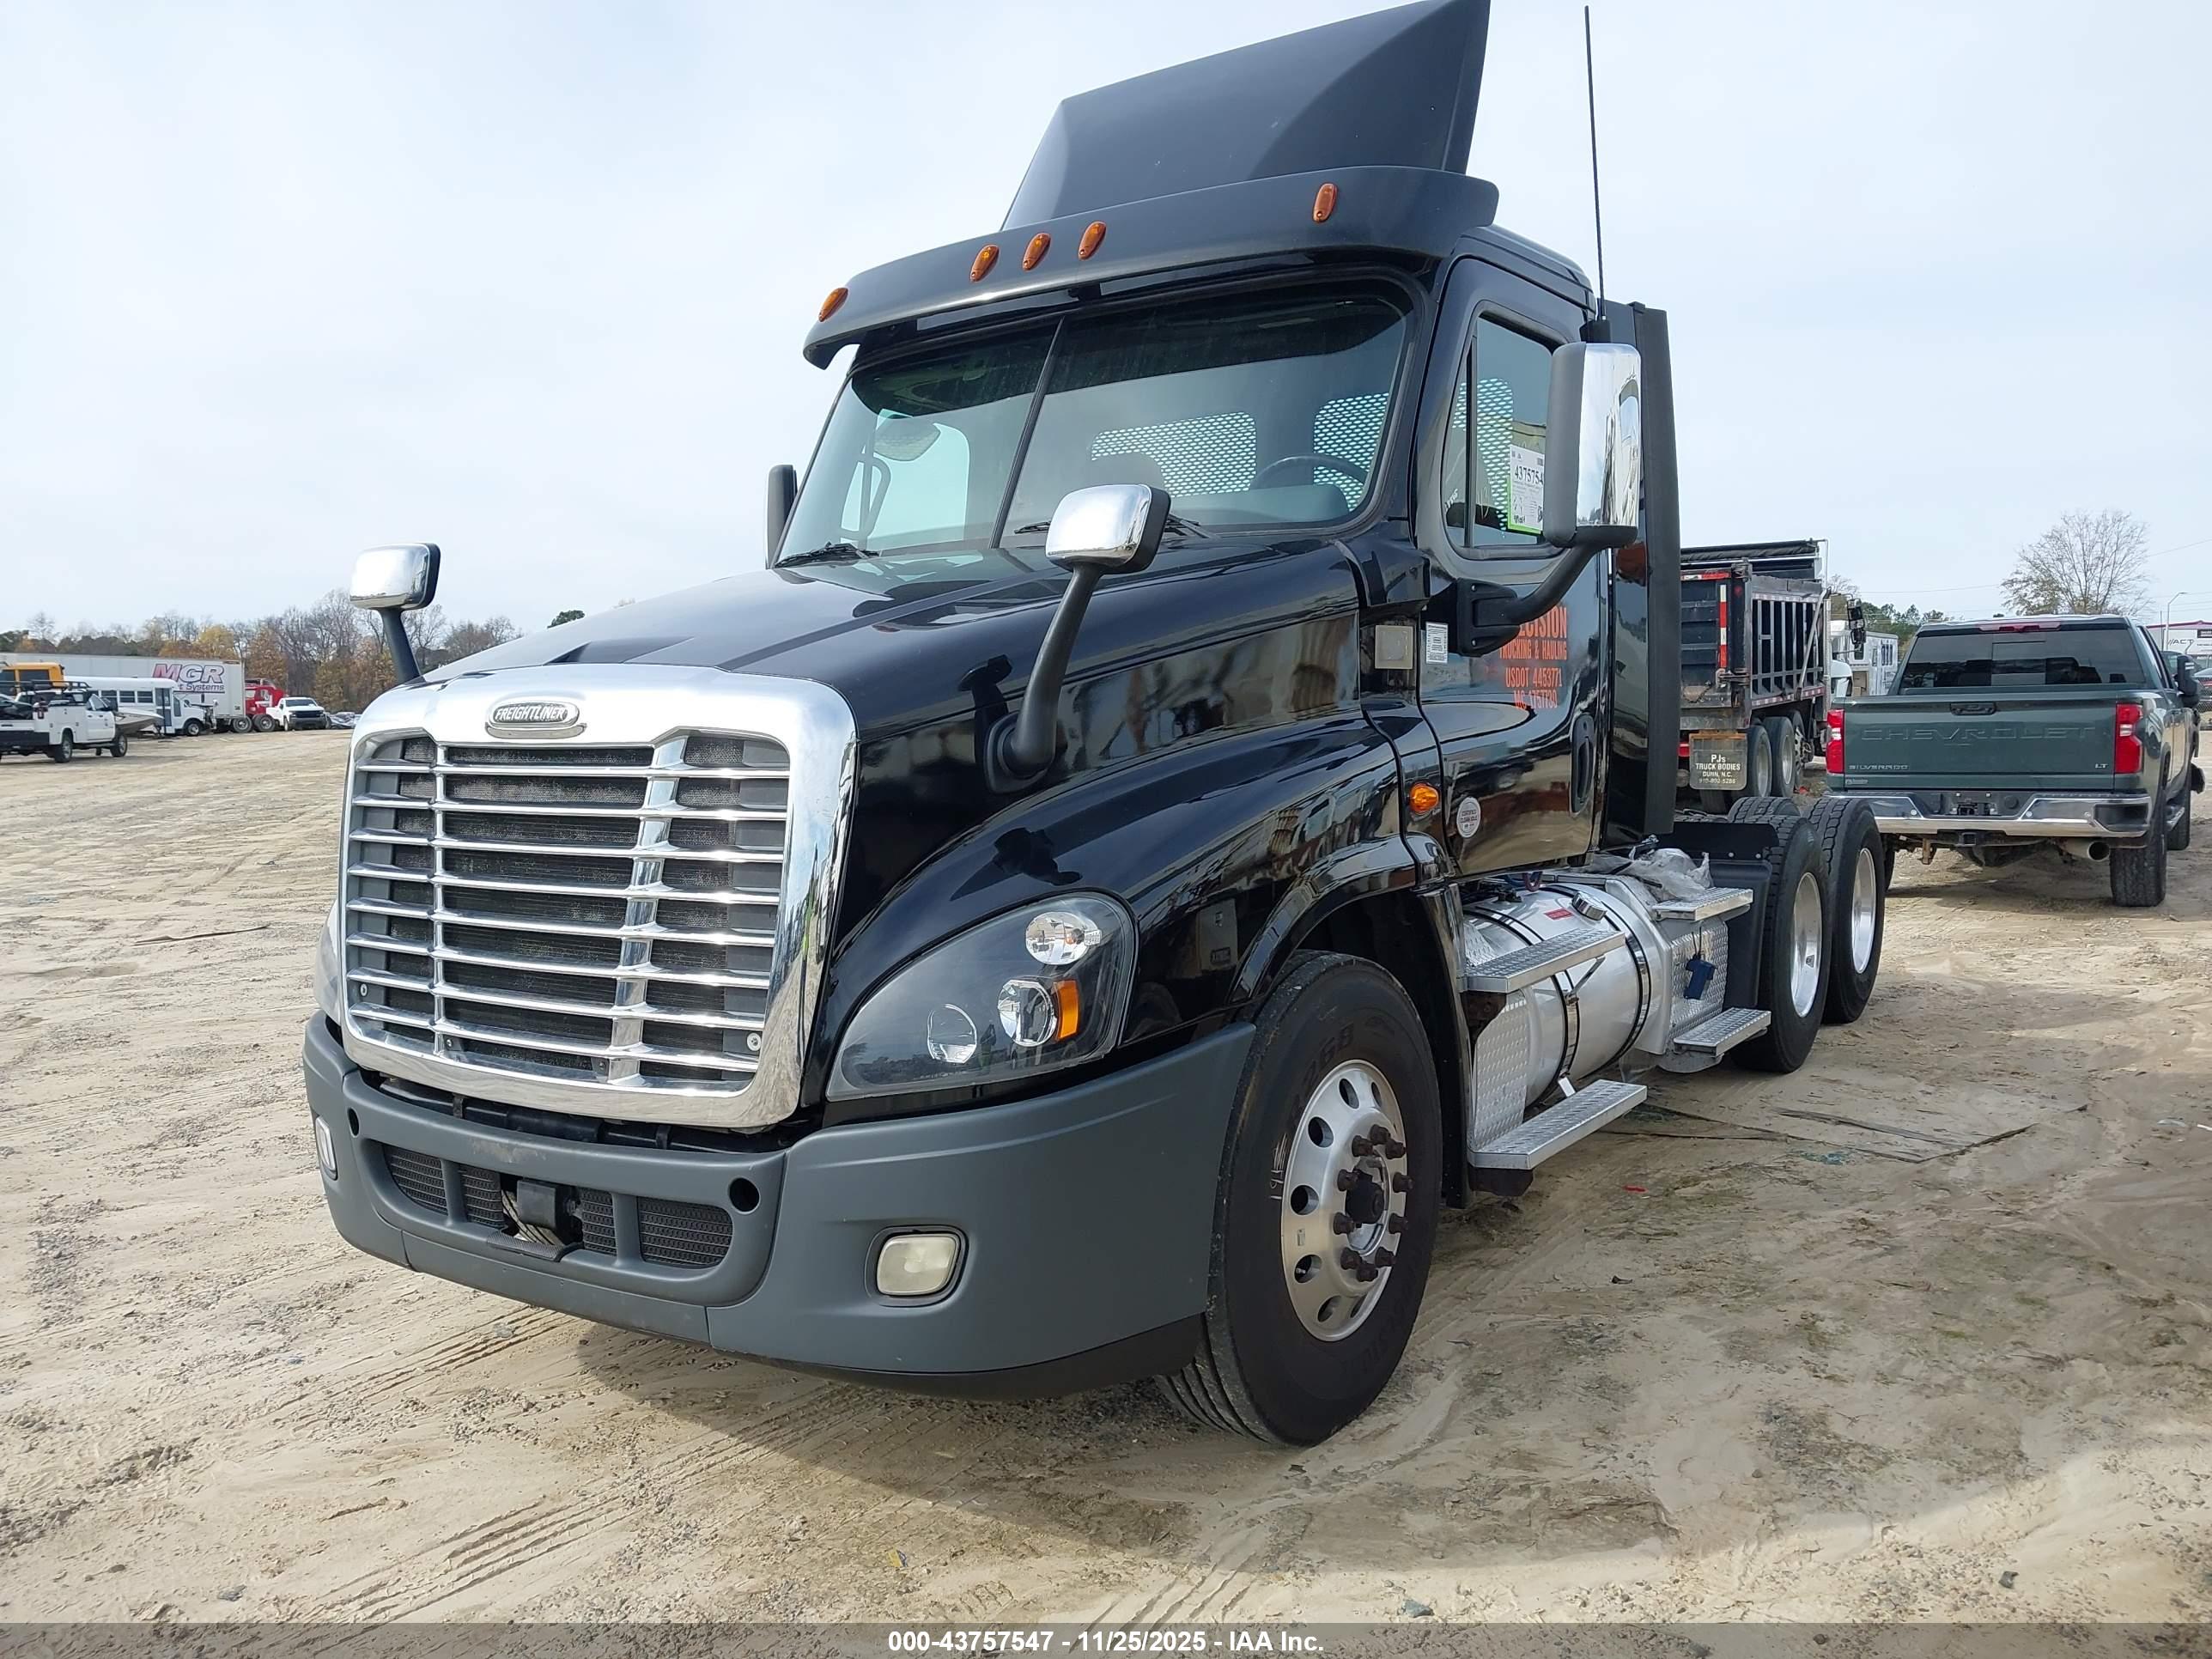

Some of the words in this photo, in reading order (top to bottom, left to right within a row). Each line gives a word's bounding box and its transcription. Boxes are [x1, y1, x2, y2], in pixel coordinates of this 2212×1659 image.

[1515, 465, 1544, 485] 4375754
[1534, 639, 1540, 659] &
[1542, 639, 1567, 660] HAULING
[153, 663, 225, 684] MGR
[1505, 667, 1529, 688] USDOT
[1533, 667, 1563, 688] 4453771
[186, 683, 225, 691] Systems
[1514, 690, 1526, 709] MC
[495, 704, 565, 722] FREIGHTLINER
[1861, 726, 2096, 741] CHEVROLET
[1711, 754, 1727, 763] PJs
